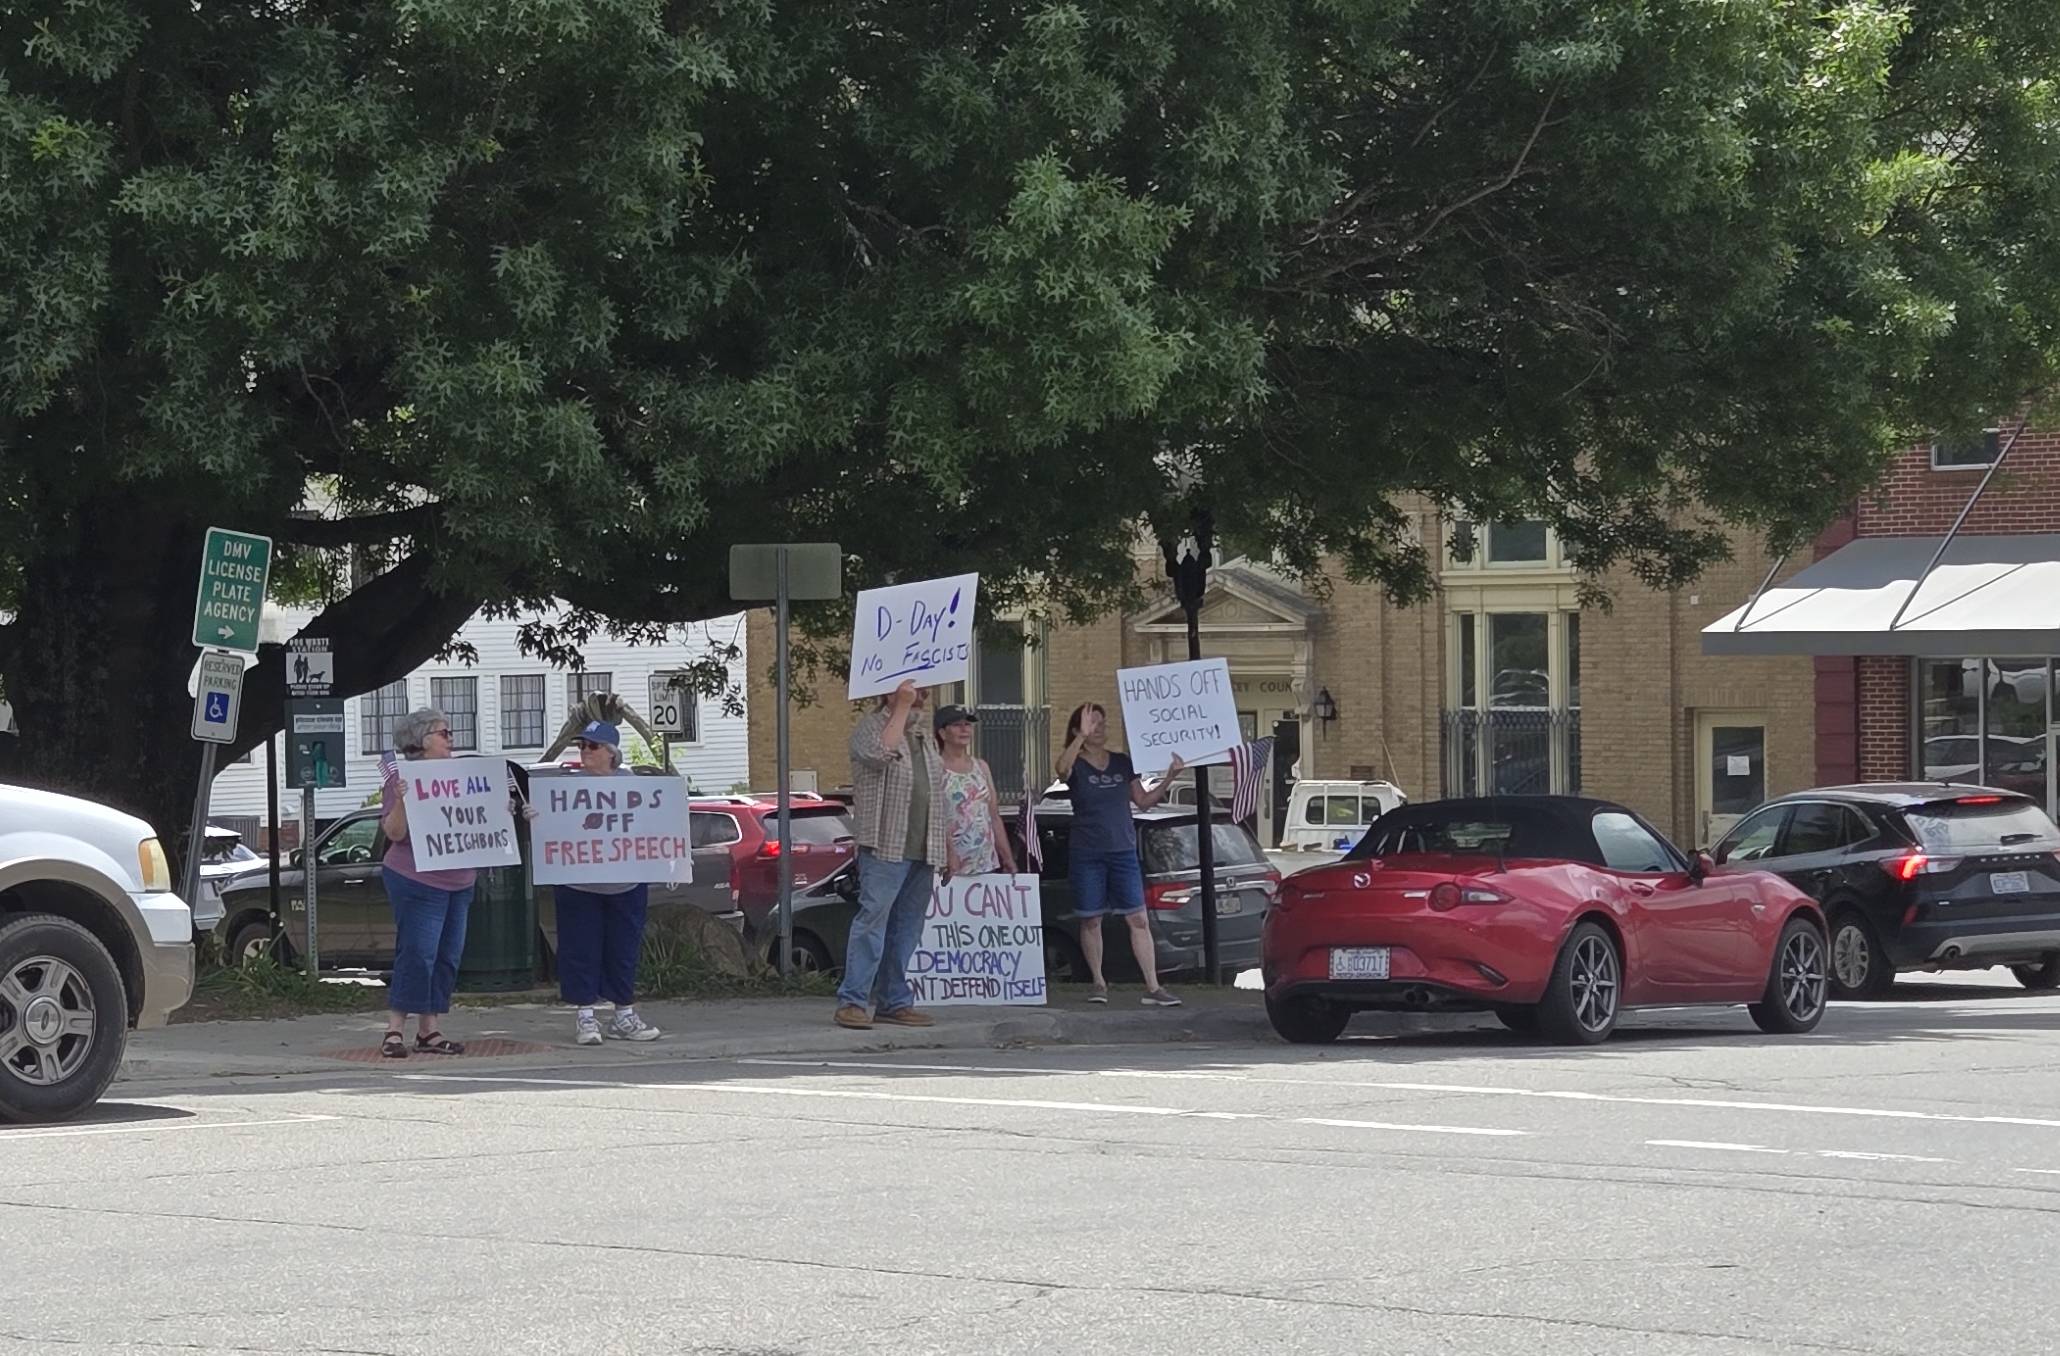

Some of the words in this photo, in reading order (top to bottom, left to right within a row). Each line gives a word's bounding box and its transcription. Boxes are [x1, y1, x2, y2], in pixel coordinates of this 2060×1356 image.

[224, 541, 252, 559] DMV
[208, 560, 262, 583] LICENSE
[212, 581, 252, 602] PLATE
[203, 601, 256, 623] AGENCY
[205, 660, 240, 675] RESERVED
[204, 675, 237, 690] PARKING
[1124, 673, 1181, 702] HANDS
[654, 705, 677, 725] 20
[1149, 704, 1208, 724] SOCIAL
[1140, 724, 1221, 748] SECURITY!
[415, 778, 461, 801] LOVE
[466, 776, 491, 795] ALL
[551, 789, 663, 812] HANDS
[441, 806, 487, 828] YOUR
[582, 812, 635, 833] OFF
[426, 828, 509, 857] NEIGHBORS
[544, 839, 604, 866] FREE
[608, 836, 686, 862] SPEECH
[924, 885, 954, 920] OU
[932, 921, 975, 948] THIS
[978, 925, 1013, 948] ONE
[1013, 925, 1042, 947] OUT
[905, 950, 1022, 981] DEMOCRACY
[905, 975, 938, 1001] ON'T
[1003, 977, 1046, 1000] ITSELF
